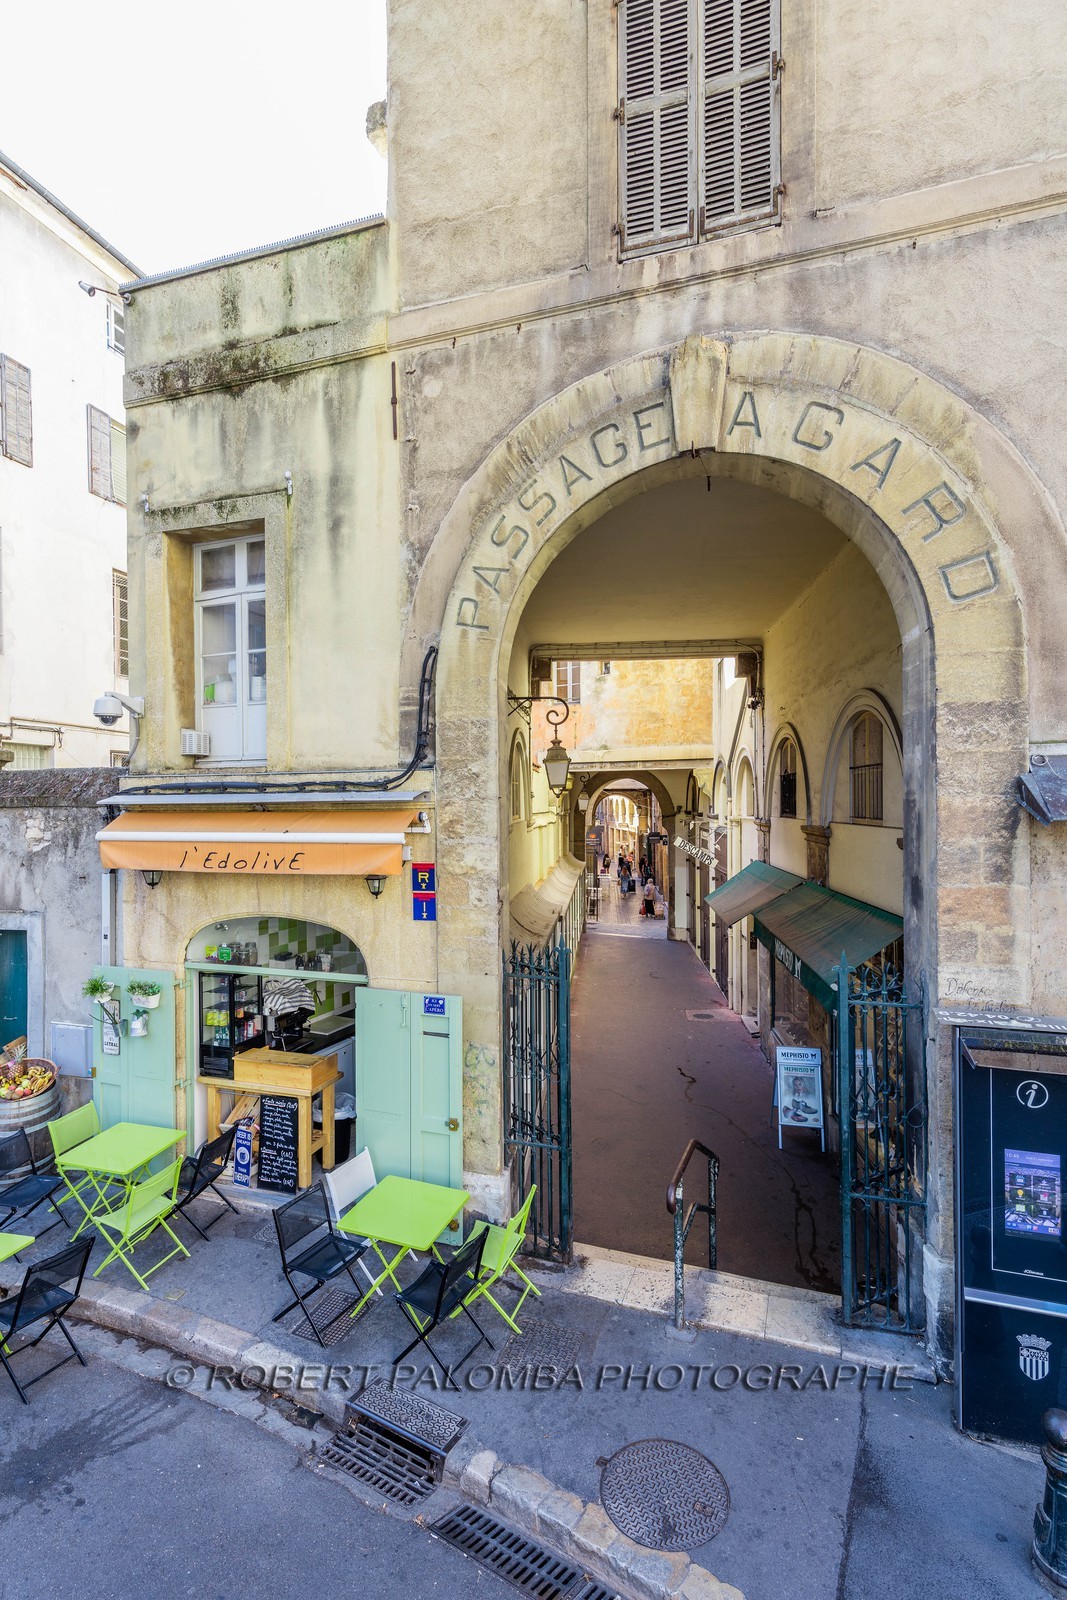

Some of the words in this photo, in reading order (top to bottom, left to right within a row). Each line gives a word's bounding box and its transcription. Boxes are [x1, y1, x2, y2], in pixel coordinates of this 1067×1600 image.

[456, 401, 672, 631] PASSAGE
[726, 390, 999, 604] AGARD
[679, 839, 714, 866] DESCAMPS
[418, 872, 429, 882] R
[236, 1130, 246, 1140] BEER
